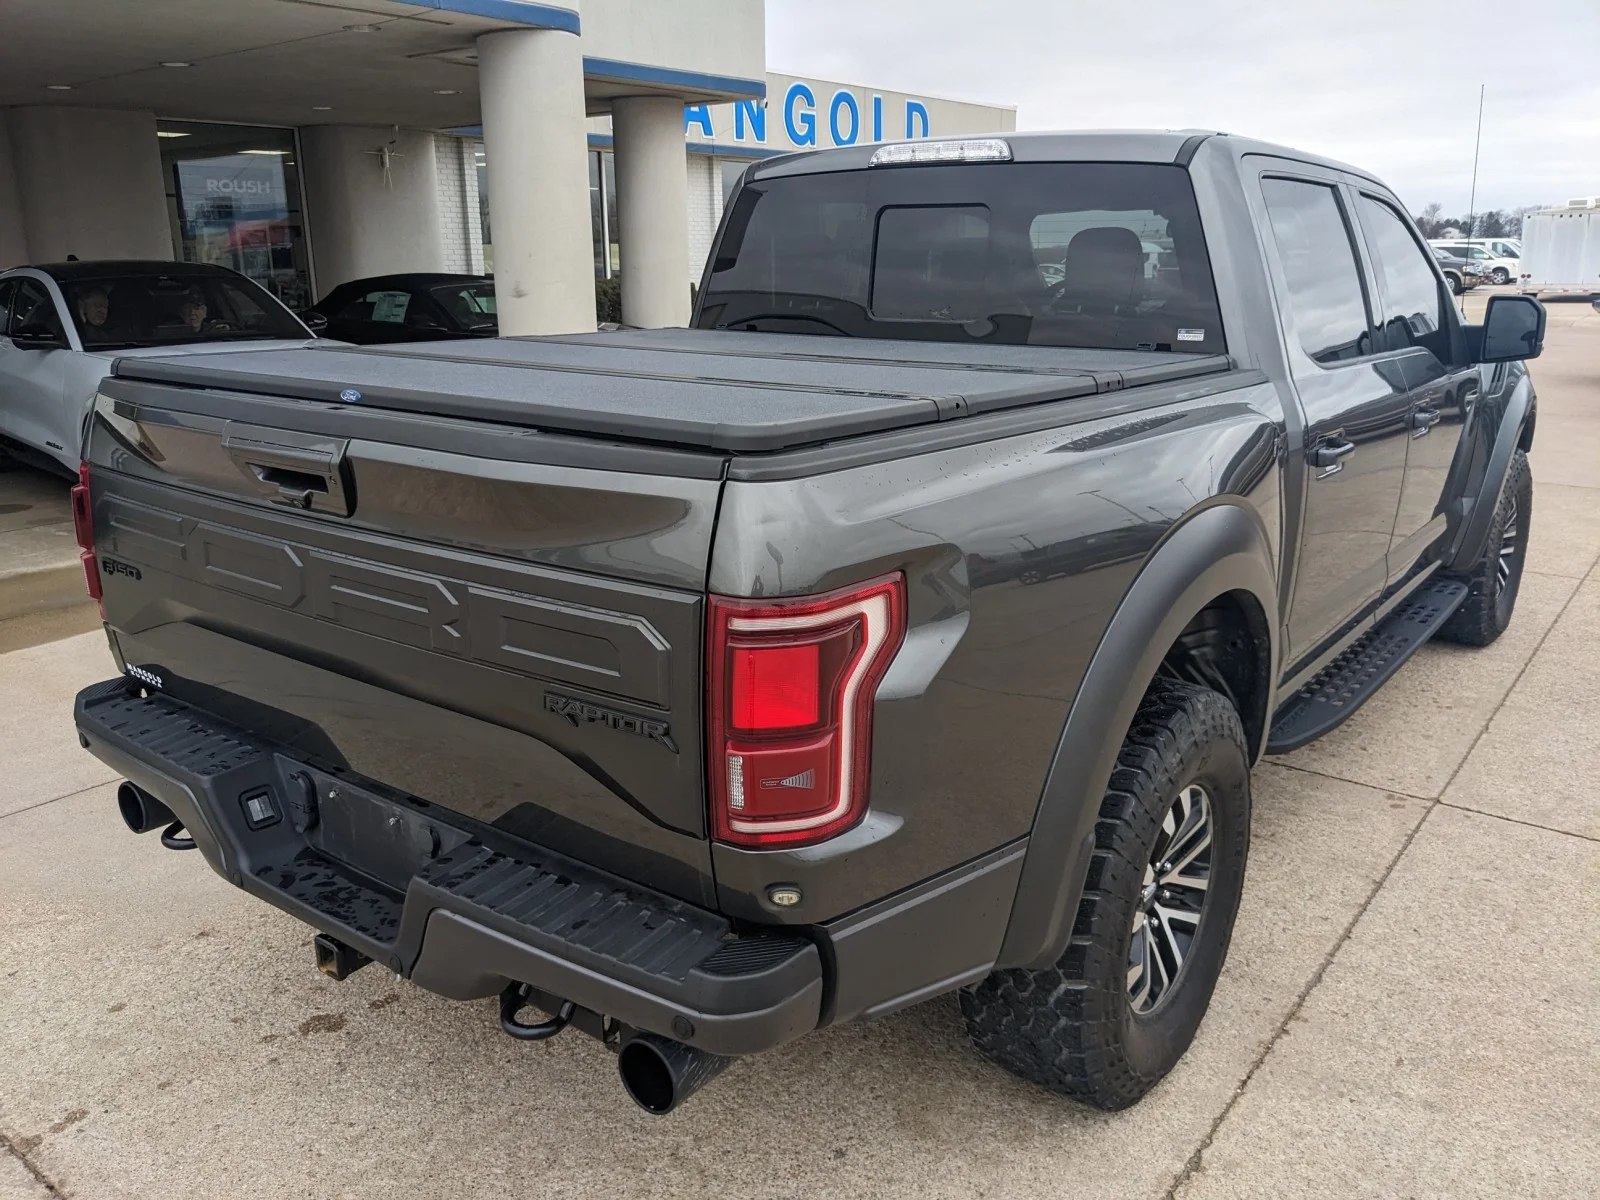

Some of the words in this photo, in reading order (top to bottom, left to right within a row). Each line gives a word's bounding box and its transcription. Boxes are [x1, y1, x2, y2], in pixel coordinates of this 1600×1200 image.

[684, 82, 929, 149] ANGOLD
[206, 179, 270, 194] ROUSH
[543, 690, 680, 755] RAPTOR
